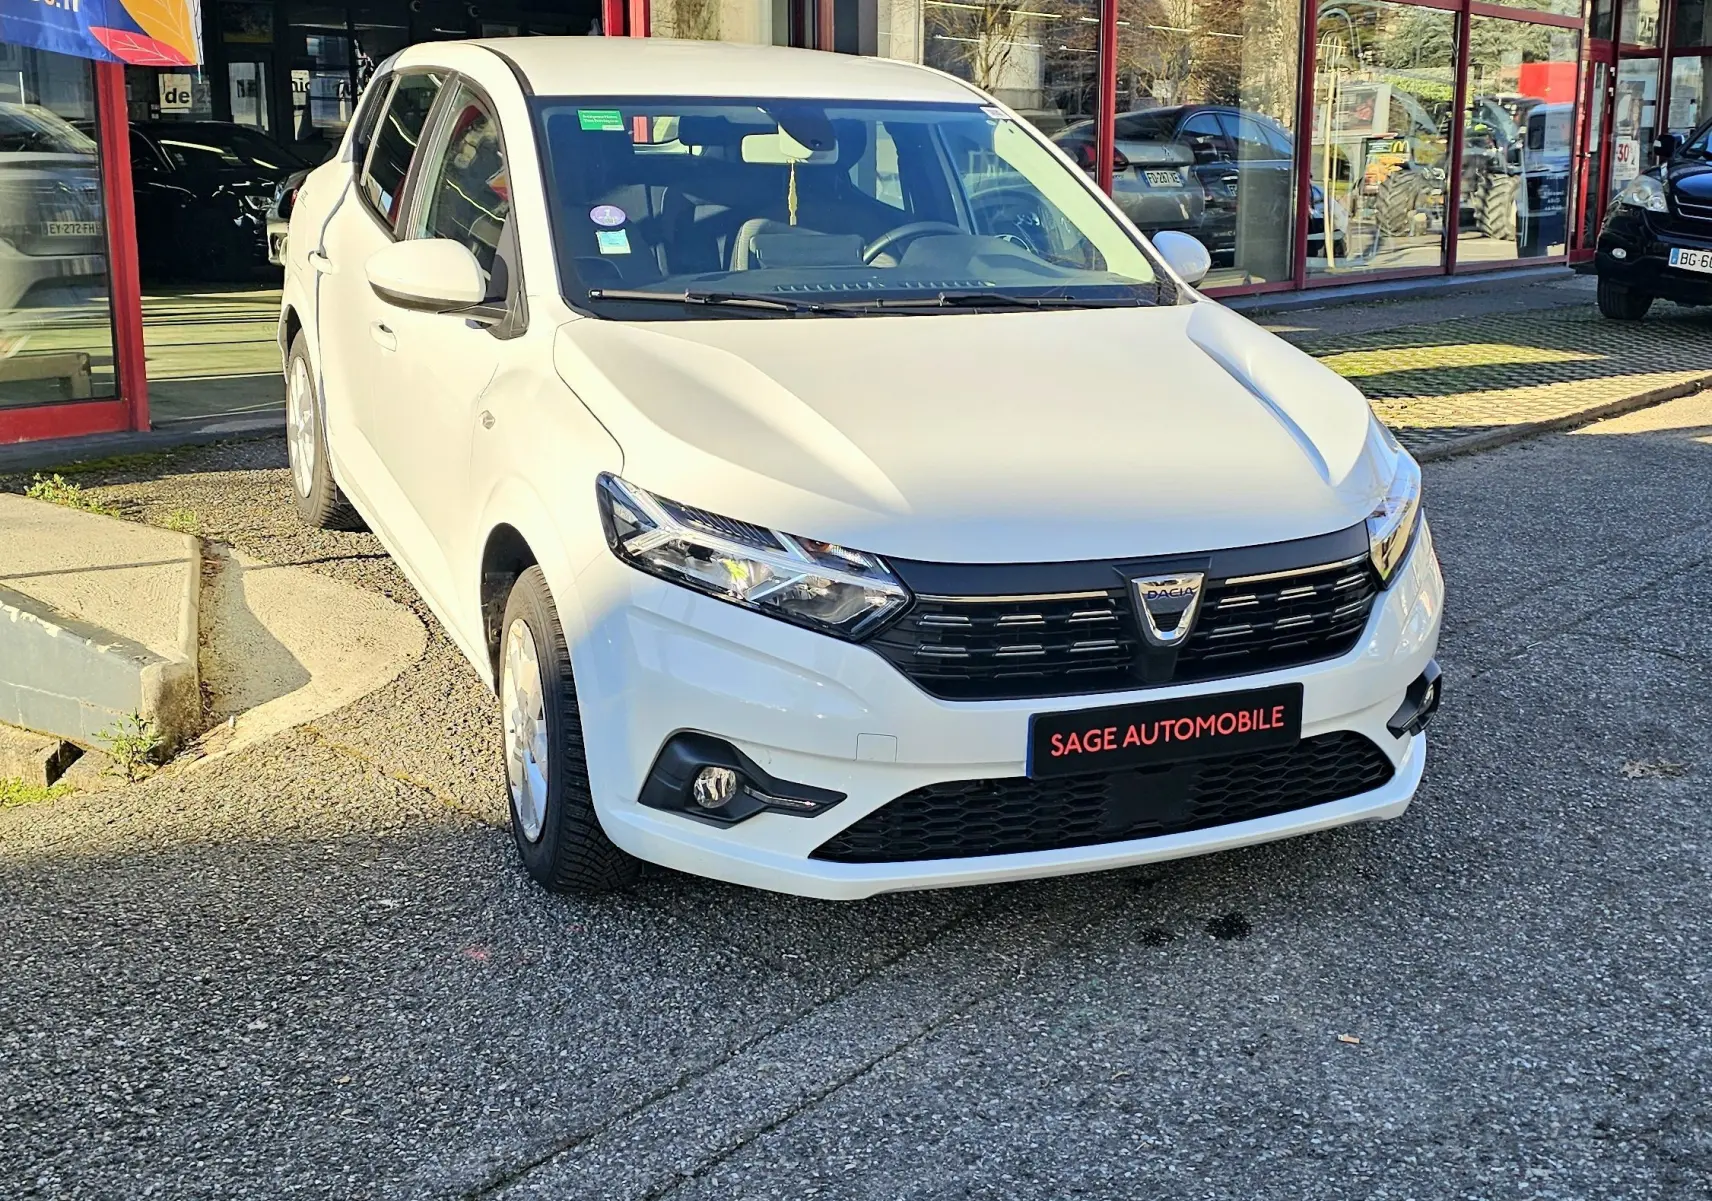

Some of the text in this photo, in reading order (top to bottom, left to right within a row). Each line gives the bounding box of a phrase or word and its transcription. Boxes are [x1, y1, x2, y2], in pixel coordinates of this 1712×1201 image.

[165, 88, 190, 103] de
[1147, 587, 1195, 600] DACIA
[1051, 705, 1286, 757] SAGE AUTOMOBILE
